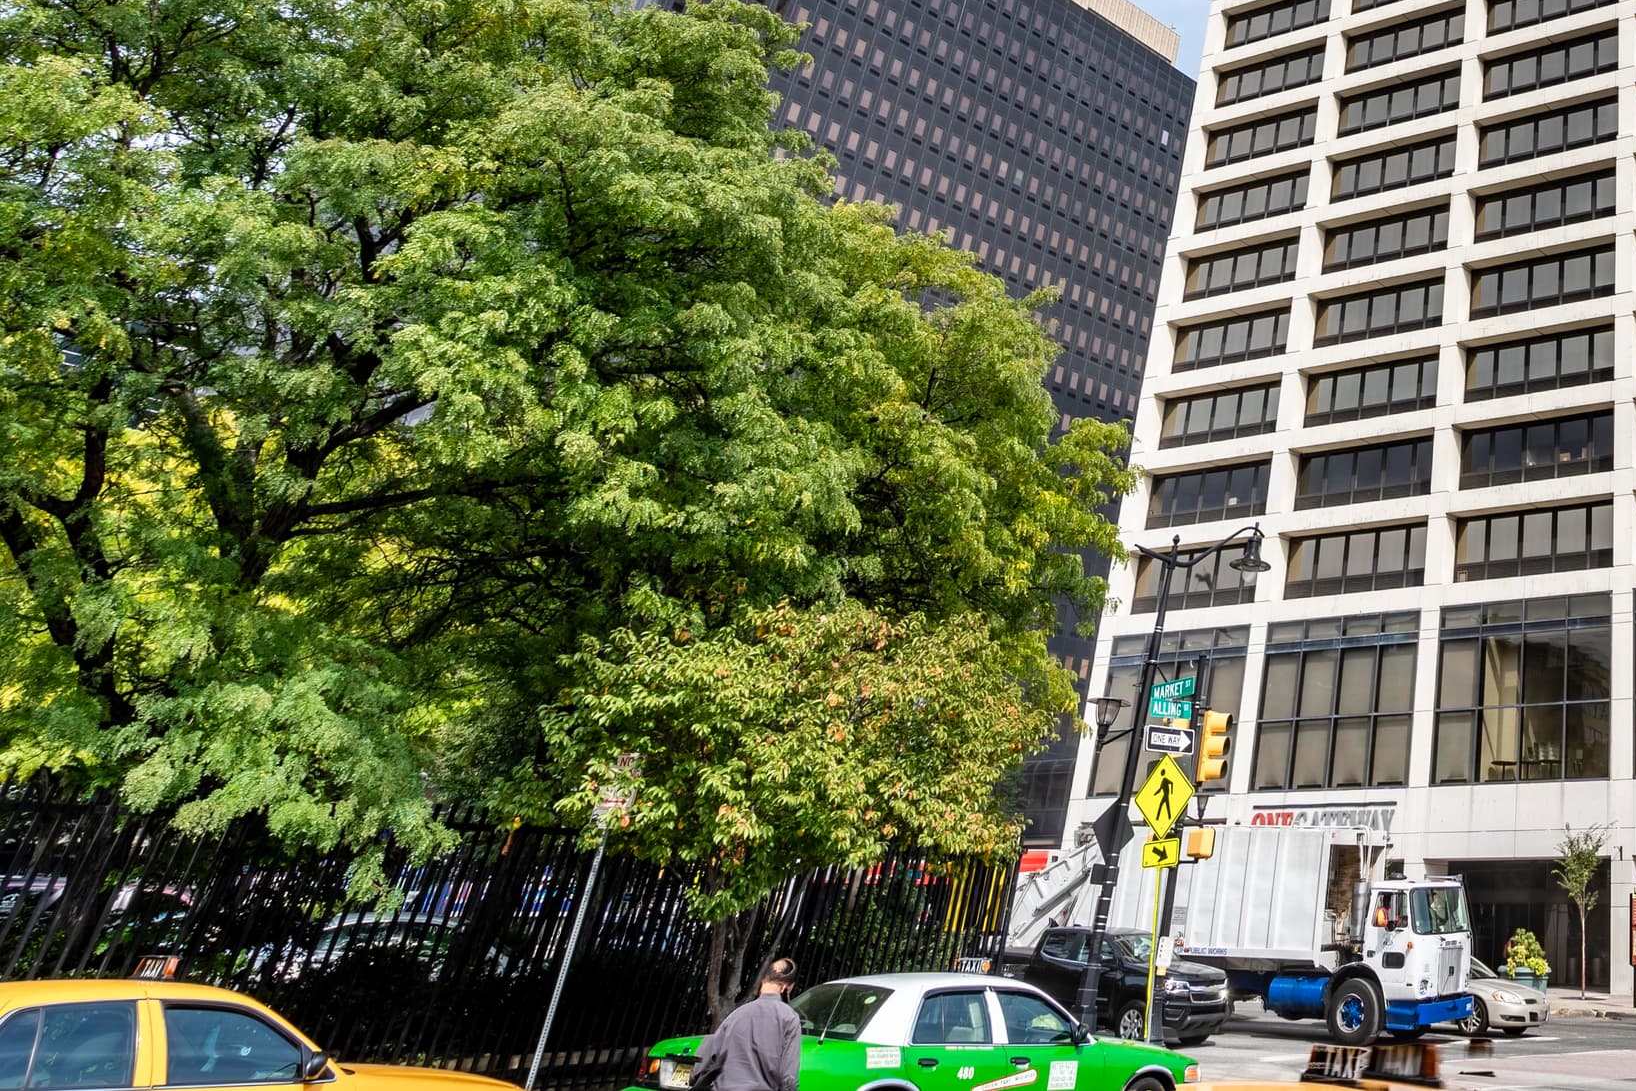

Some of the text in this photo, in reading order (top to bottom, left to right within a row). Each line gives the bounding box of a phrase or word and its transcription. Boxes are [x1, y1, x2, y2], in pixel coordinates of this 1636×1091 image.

[1153, 681, 1185, 699] MARKET
[1152, 701, 1182, 716] ALLING
[1153, 734, 1181, 745] ONE WAY
[961, 960, 980, 974] TAXI
[957, 1066, 974, 1080] 480
